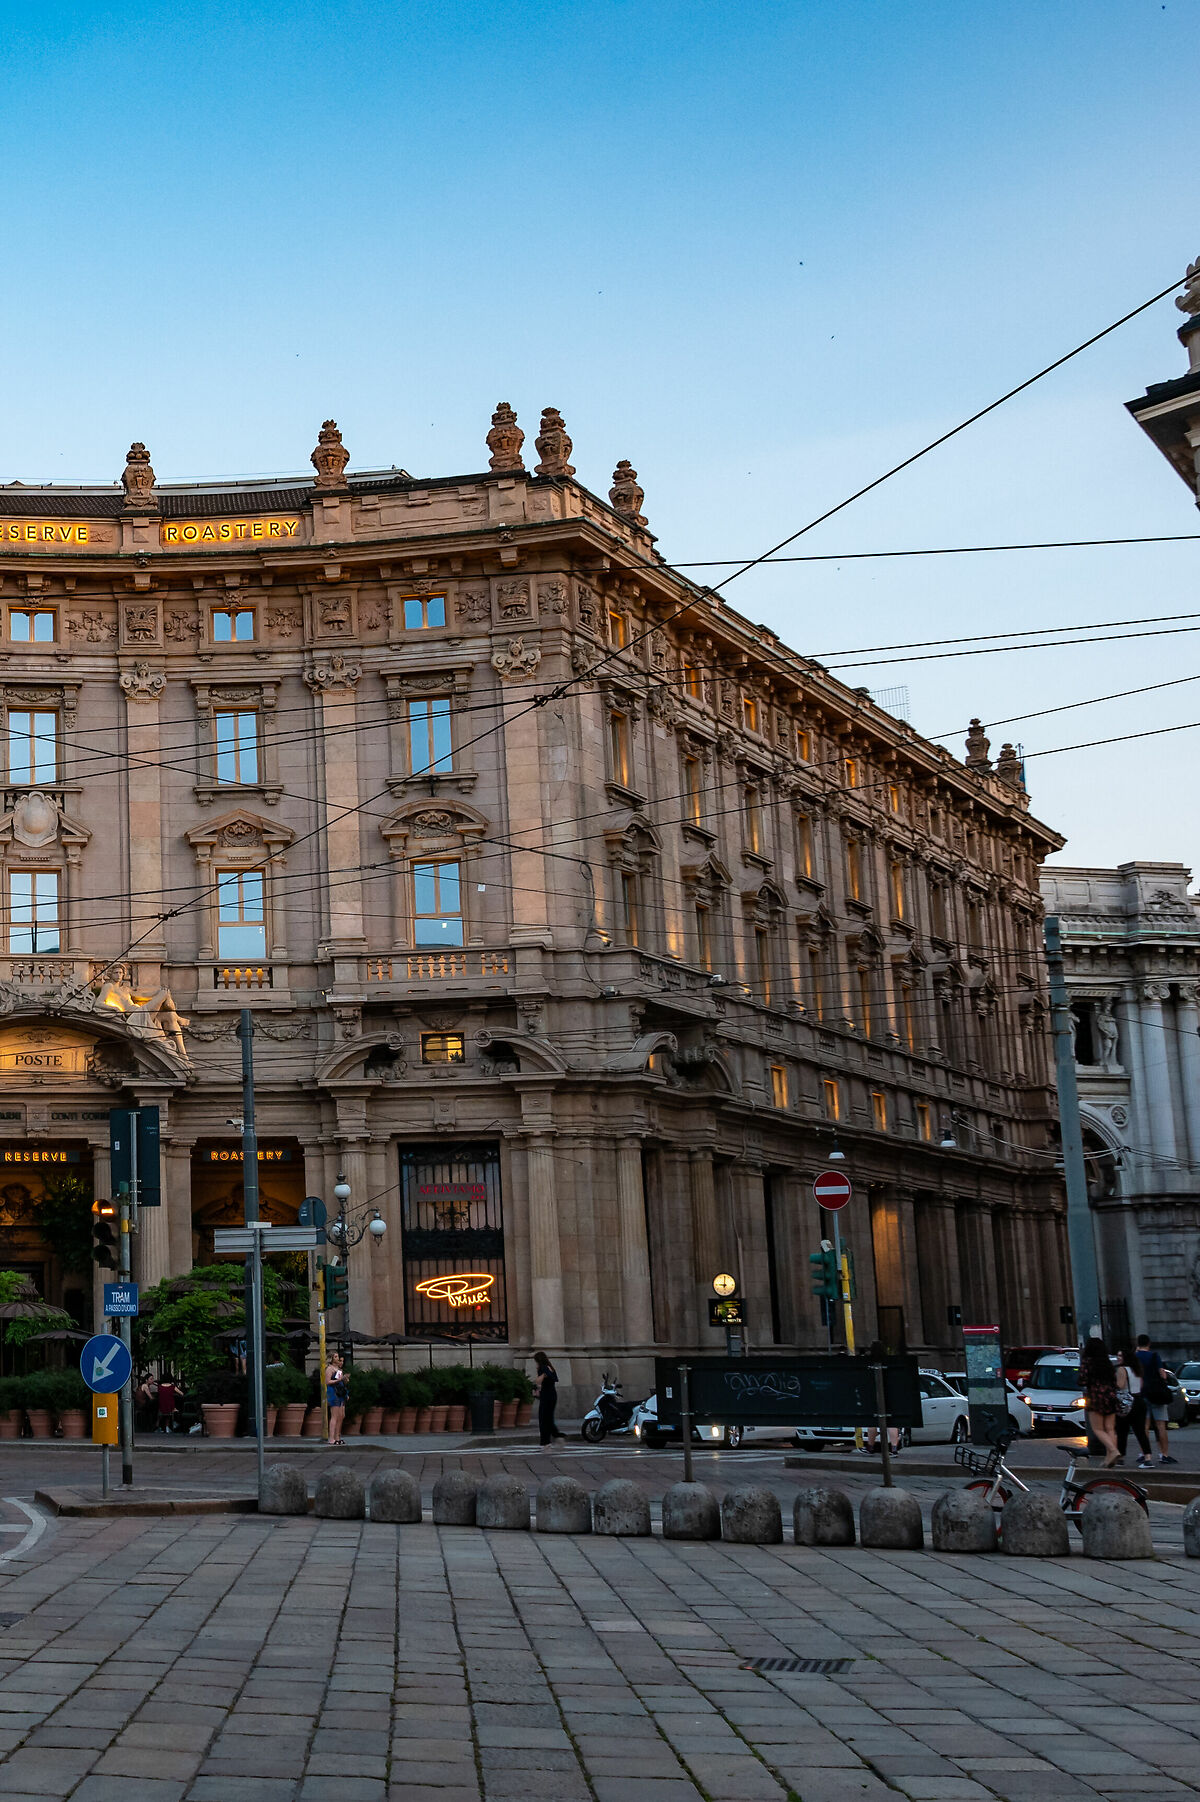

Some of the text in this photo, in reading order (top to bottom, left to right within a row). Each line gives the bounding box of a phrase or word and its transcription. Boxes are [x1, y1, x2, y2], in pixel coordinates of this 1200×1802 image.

[167, 521, 297, 541] ROASTERY
[15, 1054, 63, 1066] POSTE
[4, 1151, 68, 1162] RESERVE
[210, 1150, 283, 1161] ROASERY
[111, 1291, 131, 1304] TRAM
